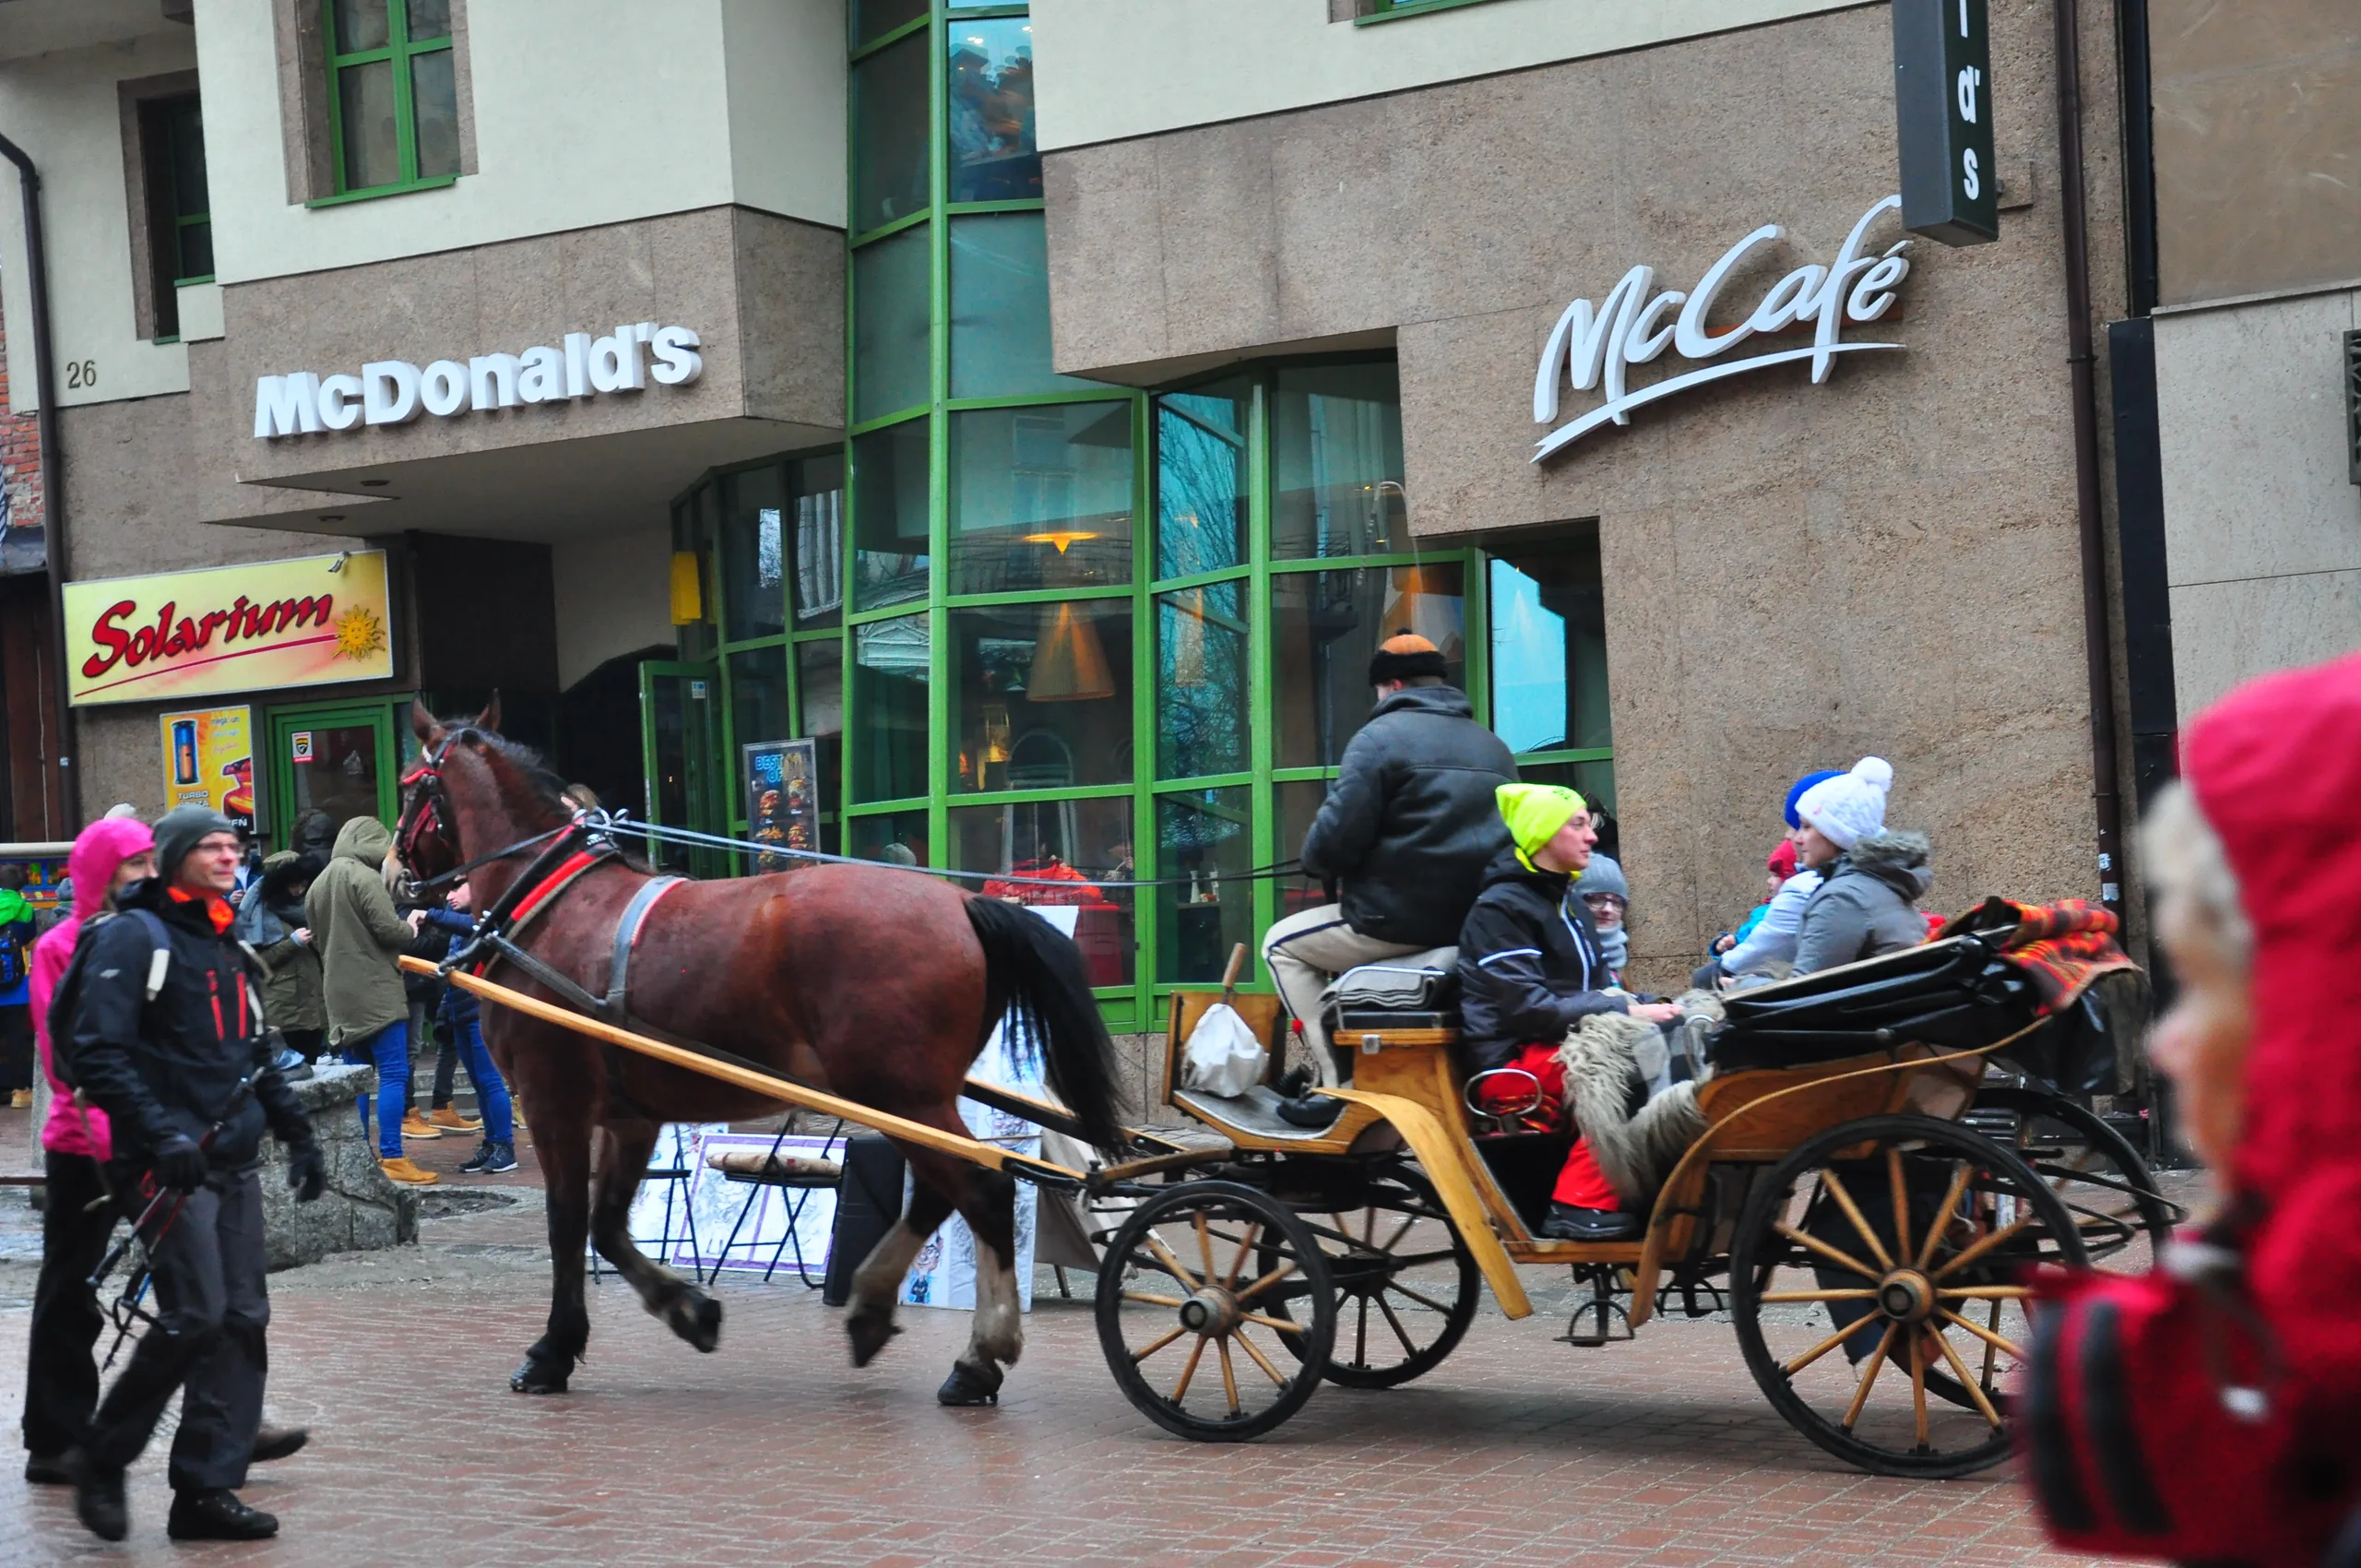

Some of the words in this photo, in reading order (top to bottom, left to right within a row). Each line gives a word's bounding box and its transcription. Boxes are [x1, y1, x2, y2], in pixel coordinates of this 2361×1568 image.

[1533, 195, 1913, 426] McCafé
[66, 360, 97, 389] 26
[254, 322, 703, 439] McDonald's
[82, 592, 334, 679] Solarium
[755, 754, 783, 770] BEST
[178, 790, 208, 800] TURBO
